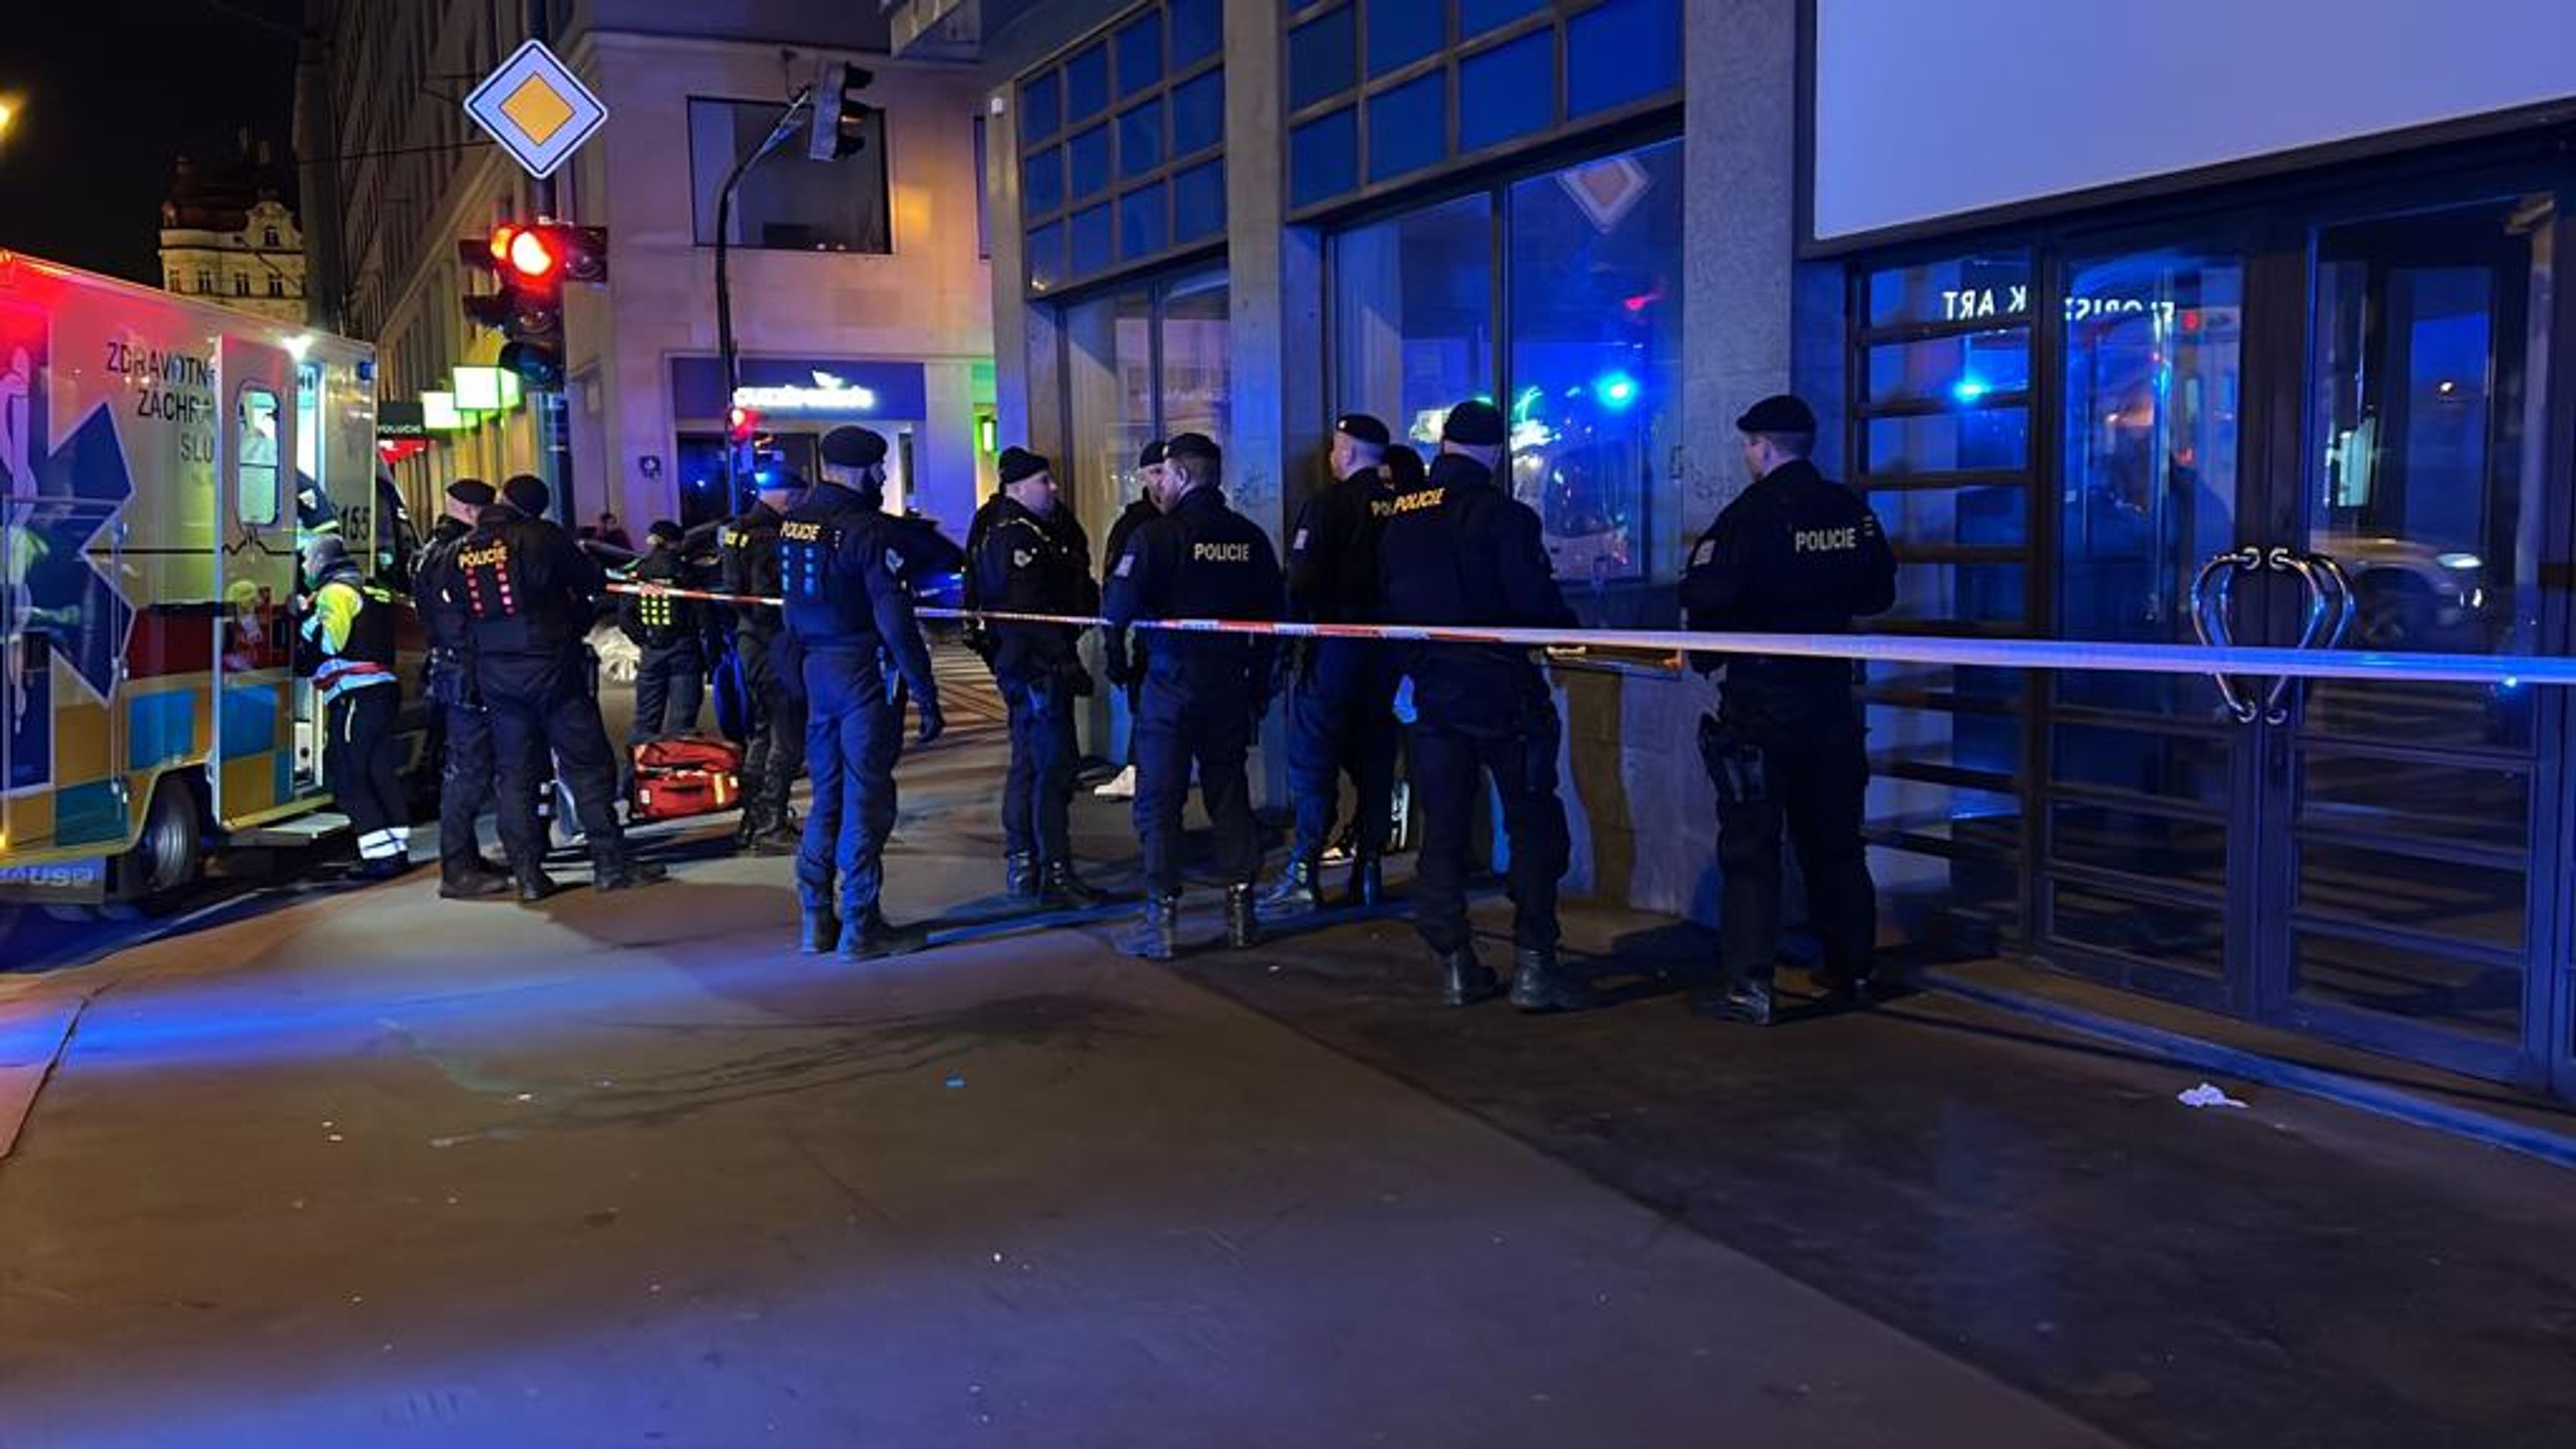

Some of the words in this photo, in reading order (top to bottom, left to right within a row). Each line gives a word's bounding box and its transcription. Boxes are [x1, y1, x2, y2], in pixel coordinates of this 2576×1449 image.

[1393, 487, 1445, 514] POLICIE
[1194, 543, 1250, 561] POLICIE
[1795, 527, 1857, 552] POLICIE
